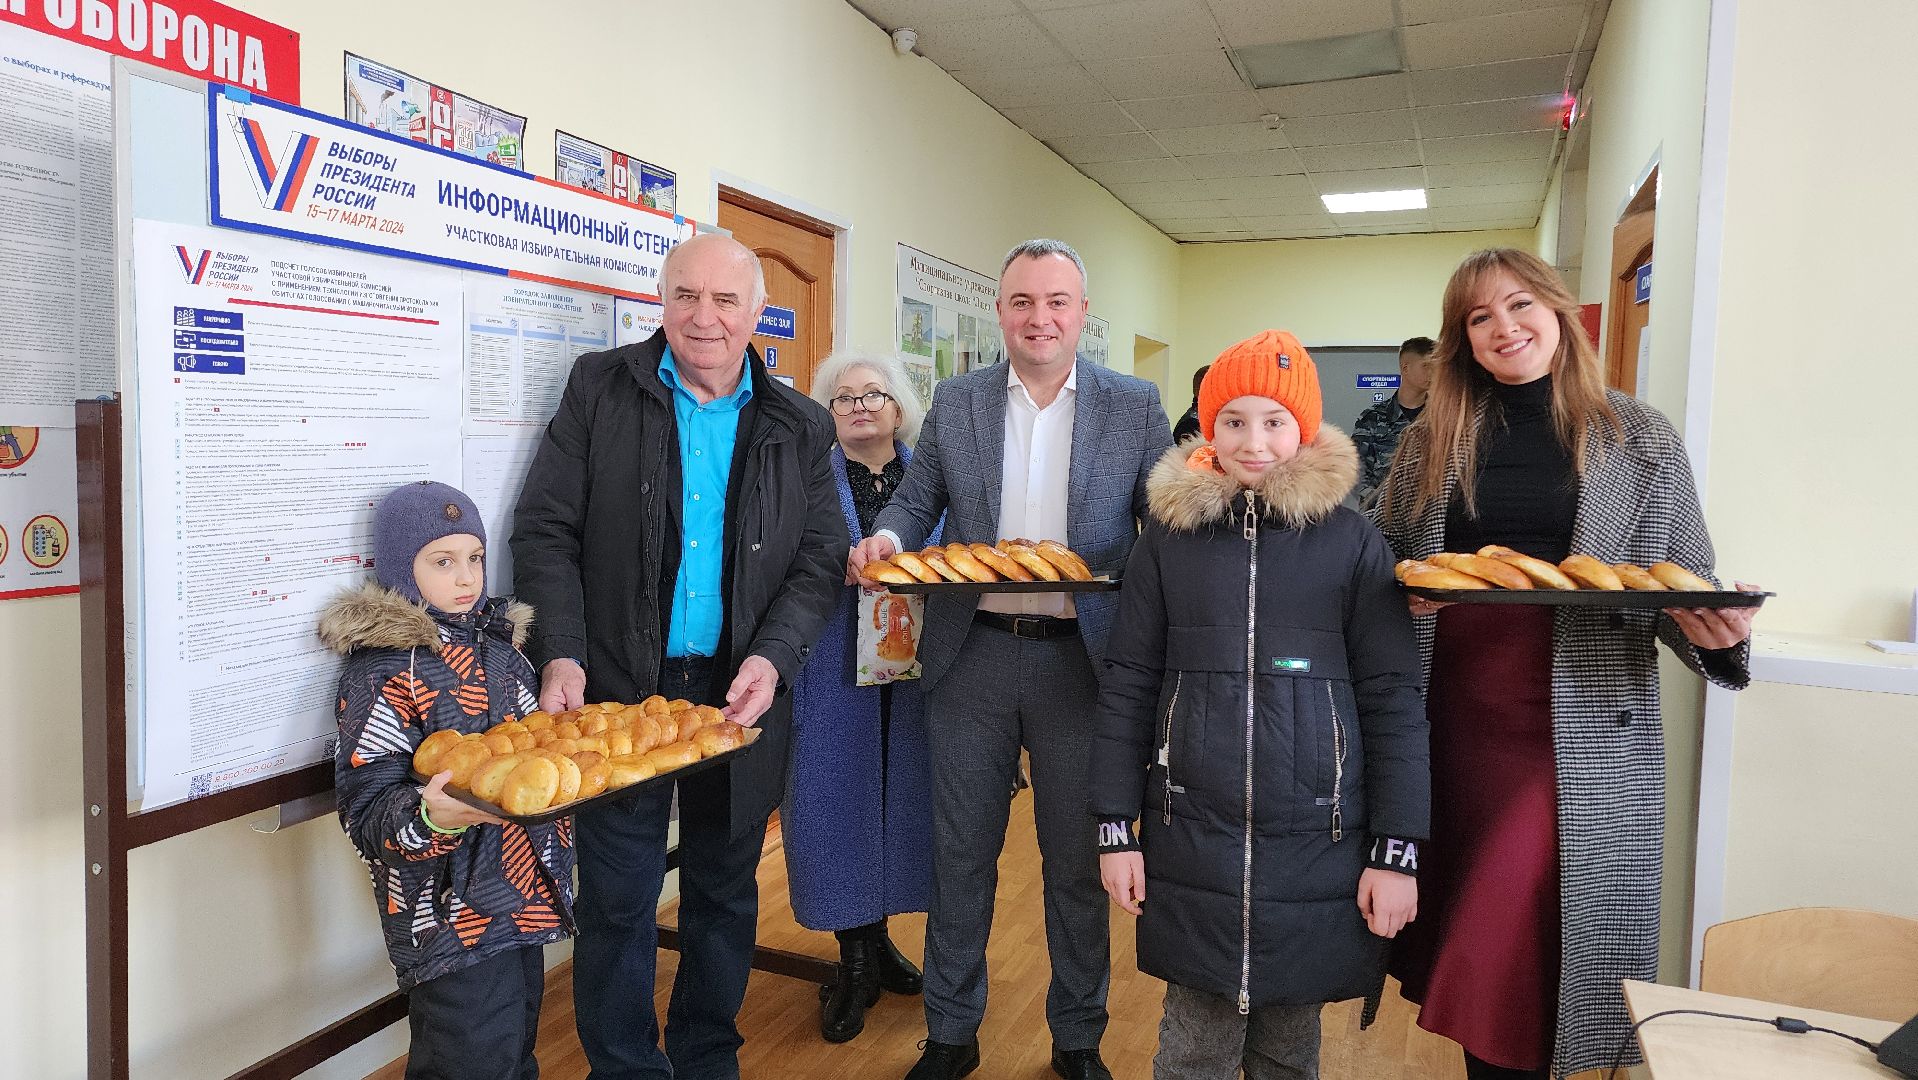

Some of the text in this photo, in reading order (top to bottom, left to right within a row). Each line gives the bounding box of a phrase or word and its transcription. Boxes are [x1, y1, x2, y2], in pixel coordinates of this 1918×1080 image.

[11, 58, 51, 74] выборах
[328, 141, 397, 172] ВЫБОРЫ
[320, 162, 416, 198] ПРЕЗИДЕНТА
[312, 183, 377, 211] РОССИИ
[340, 210, 378, 231] МАРТА
[379, 219, 404, 235] 2024
[438, 179, 629, 248] ИНФОРМАЦИОННЫЙ
[216, 252, 249, 262] ВЫБОРЫ
[446, 224, 518, 250] УЧАСТКОВАЯ
[521, 240, 601, 267] ИЗБИРАТЕЛЬНАЯ
[603, 258, 648, 277] КОМИССИЯ
[209, 271, 239, 281] РОССИИ
[212, 261, 258, 273] ПРЕЗИДЕНТА
[778, 318, 791, 329] ЗАЛ
[769, 350, 775, 365] 3
[1374, 393, 1383, 401] 12
[1384, 838, 1418, 870] FA
